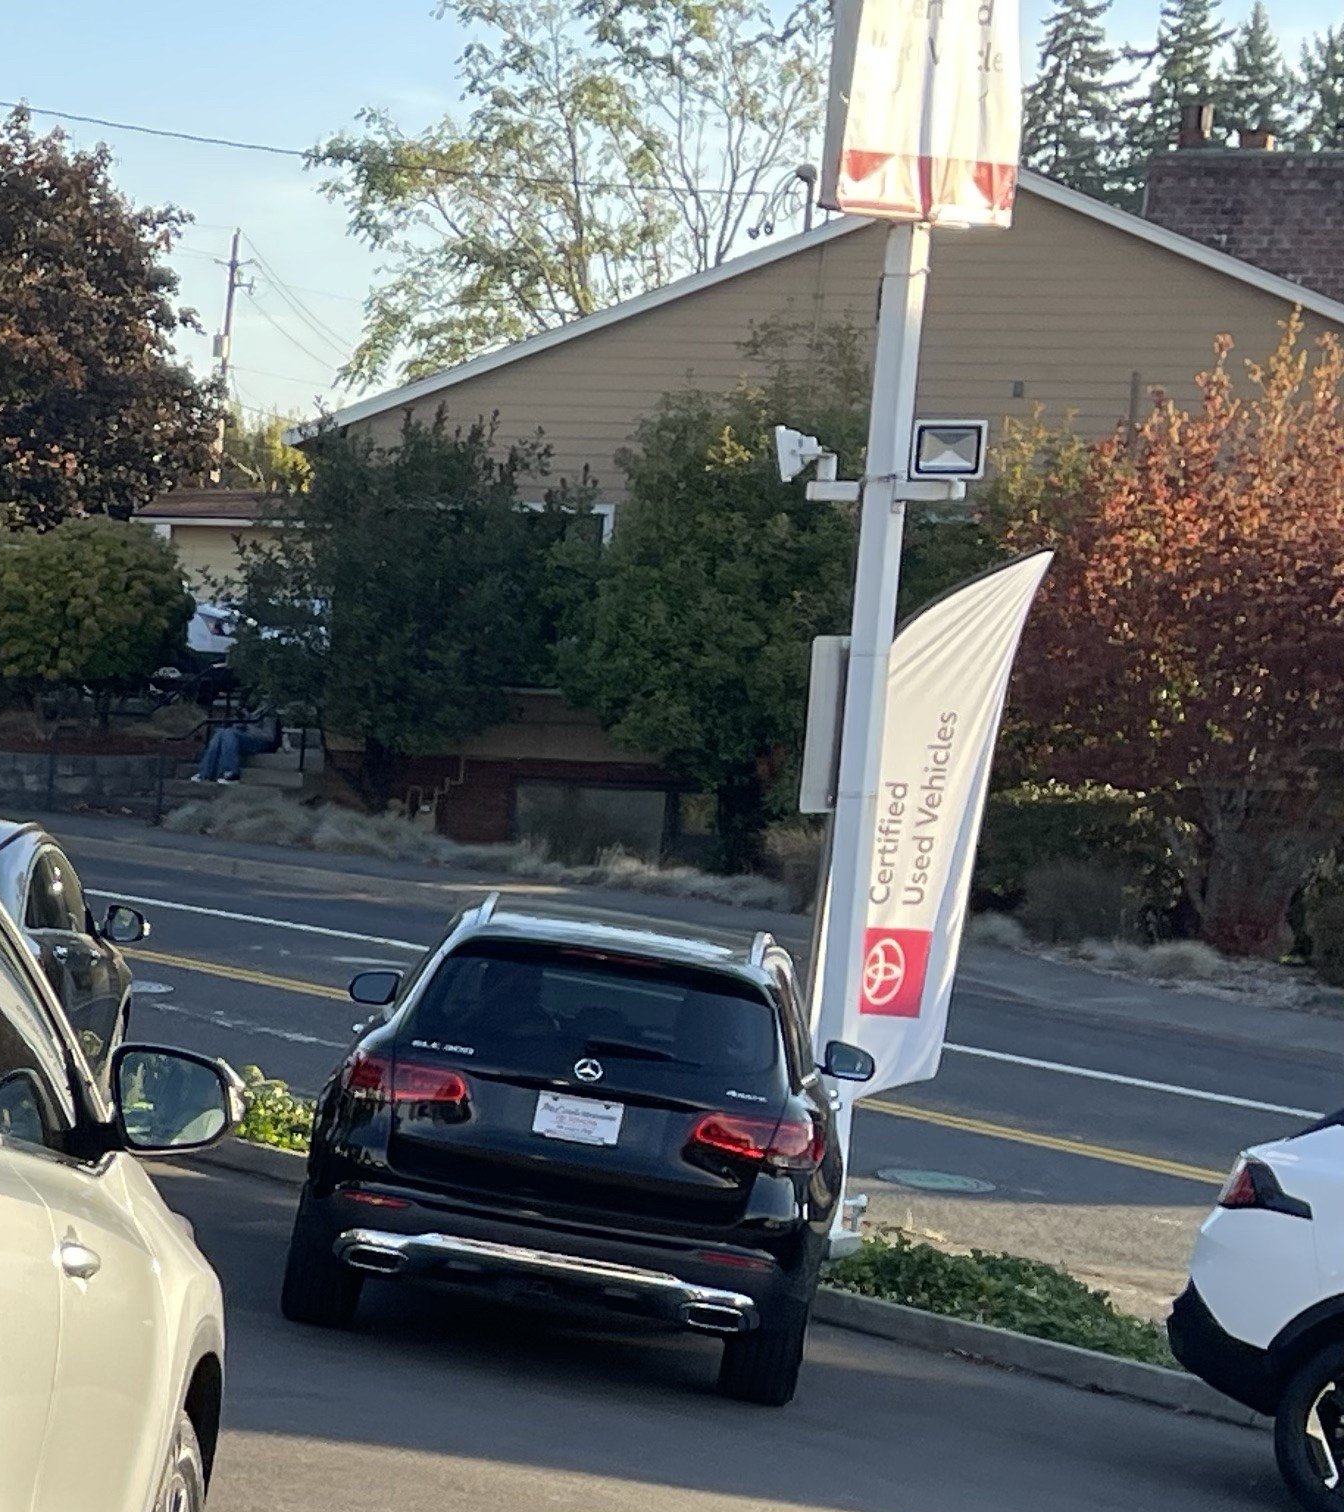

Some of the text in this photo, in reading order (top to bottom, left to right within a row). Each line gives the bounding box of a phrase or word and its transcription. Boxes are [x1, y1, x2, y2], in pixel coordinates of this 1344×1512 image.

[869, 780, 909, 906] Certified
[902, 710, 959, 906] Used Vehicles
